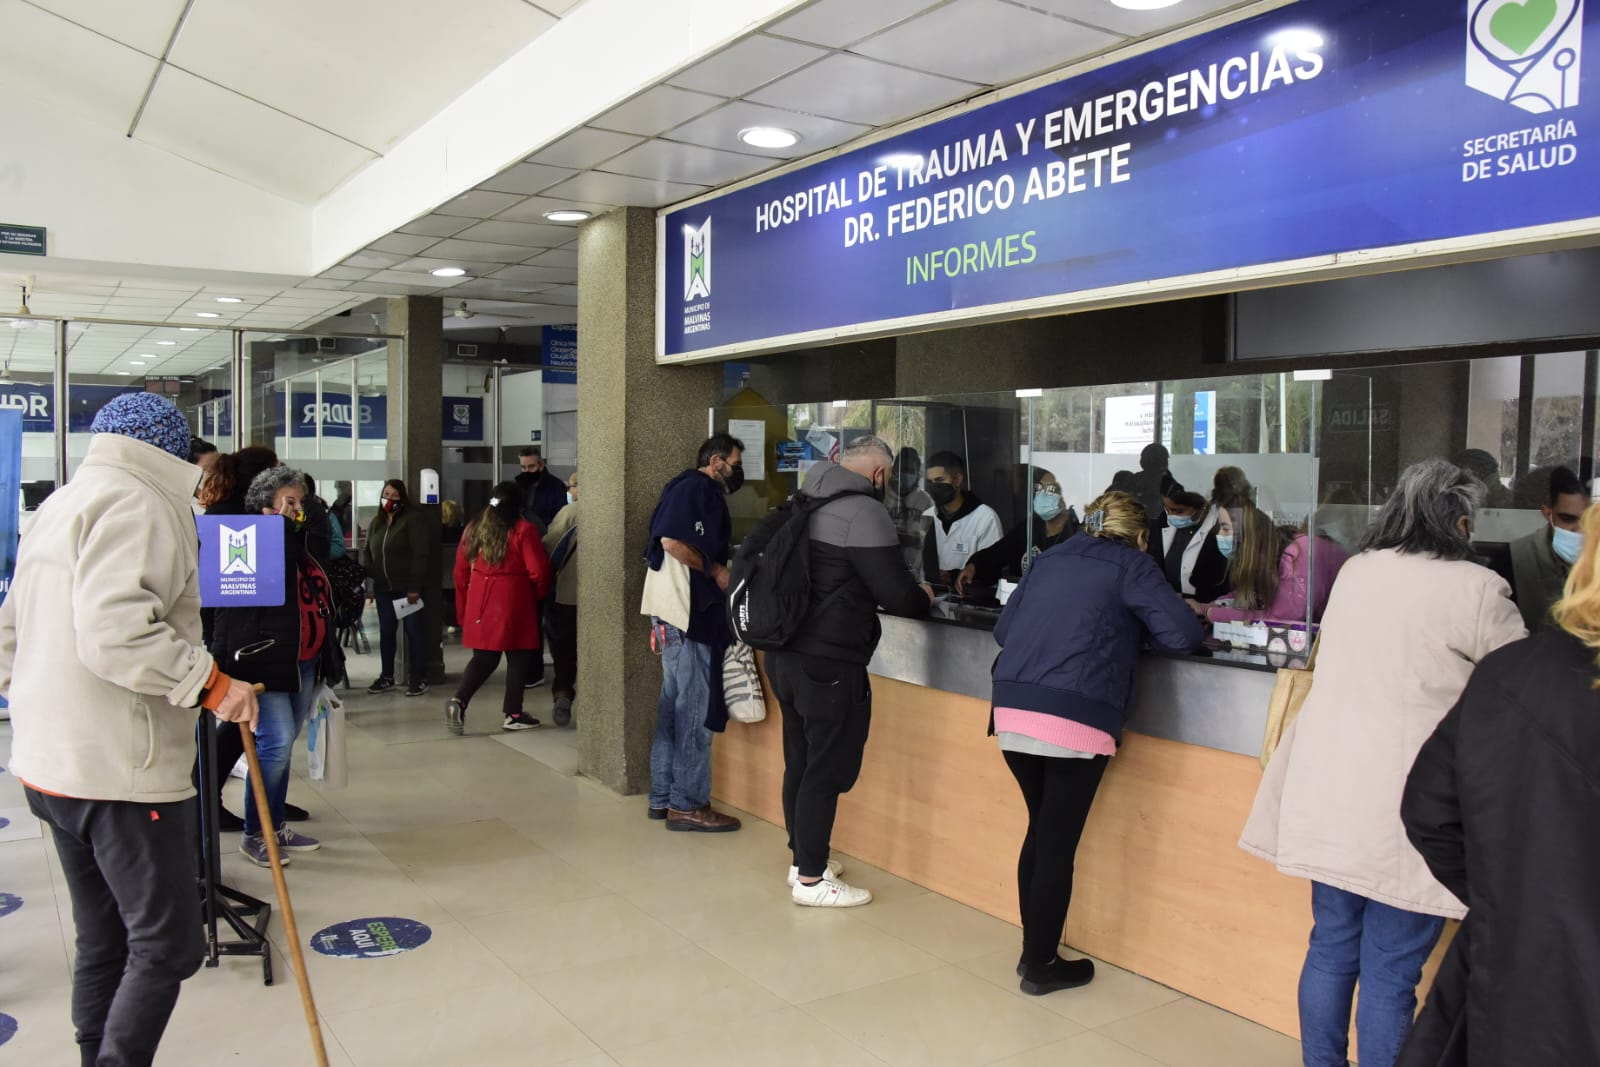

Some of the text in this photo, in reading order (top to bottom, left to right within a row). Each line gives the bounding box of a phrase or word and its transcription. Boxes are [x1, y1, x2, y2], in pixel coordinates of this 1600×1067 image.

[756, 32, 1324, 233] HOSPITAL DE TRAUMA Y EMERGENCIAS
[1463, 118, 1578, 157] SECRETARÍA
[1462, 143, 1577, 182] DE SALUD
[844, 142, 1131, 248] DR. FEDERICO ABETE
[906, 230, 1037, 286] INFORMES
[684, 311, 711, 326] MALVINAS
[684, 322, 711, 335] ARGENTINAS
[348, 929, 380, 949] AQUÍ
